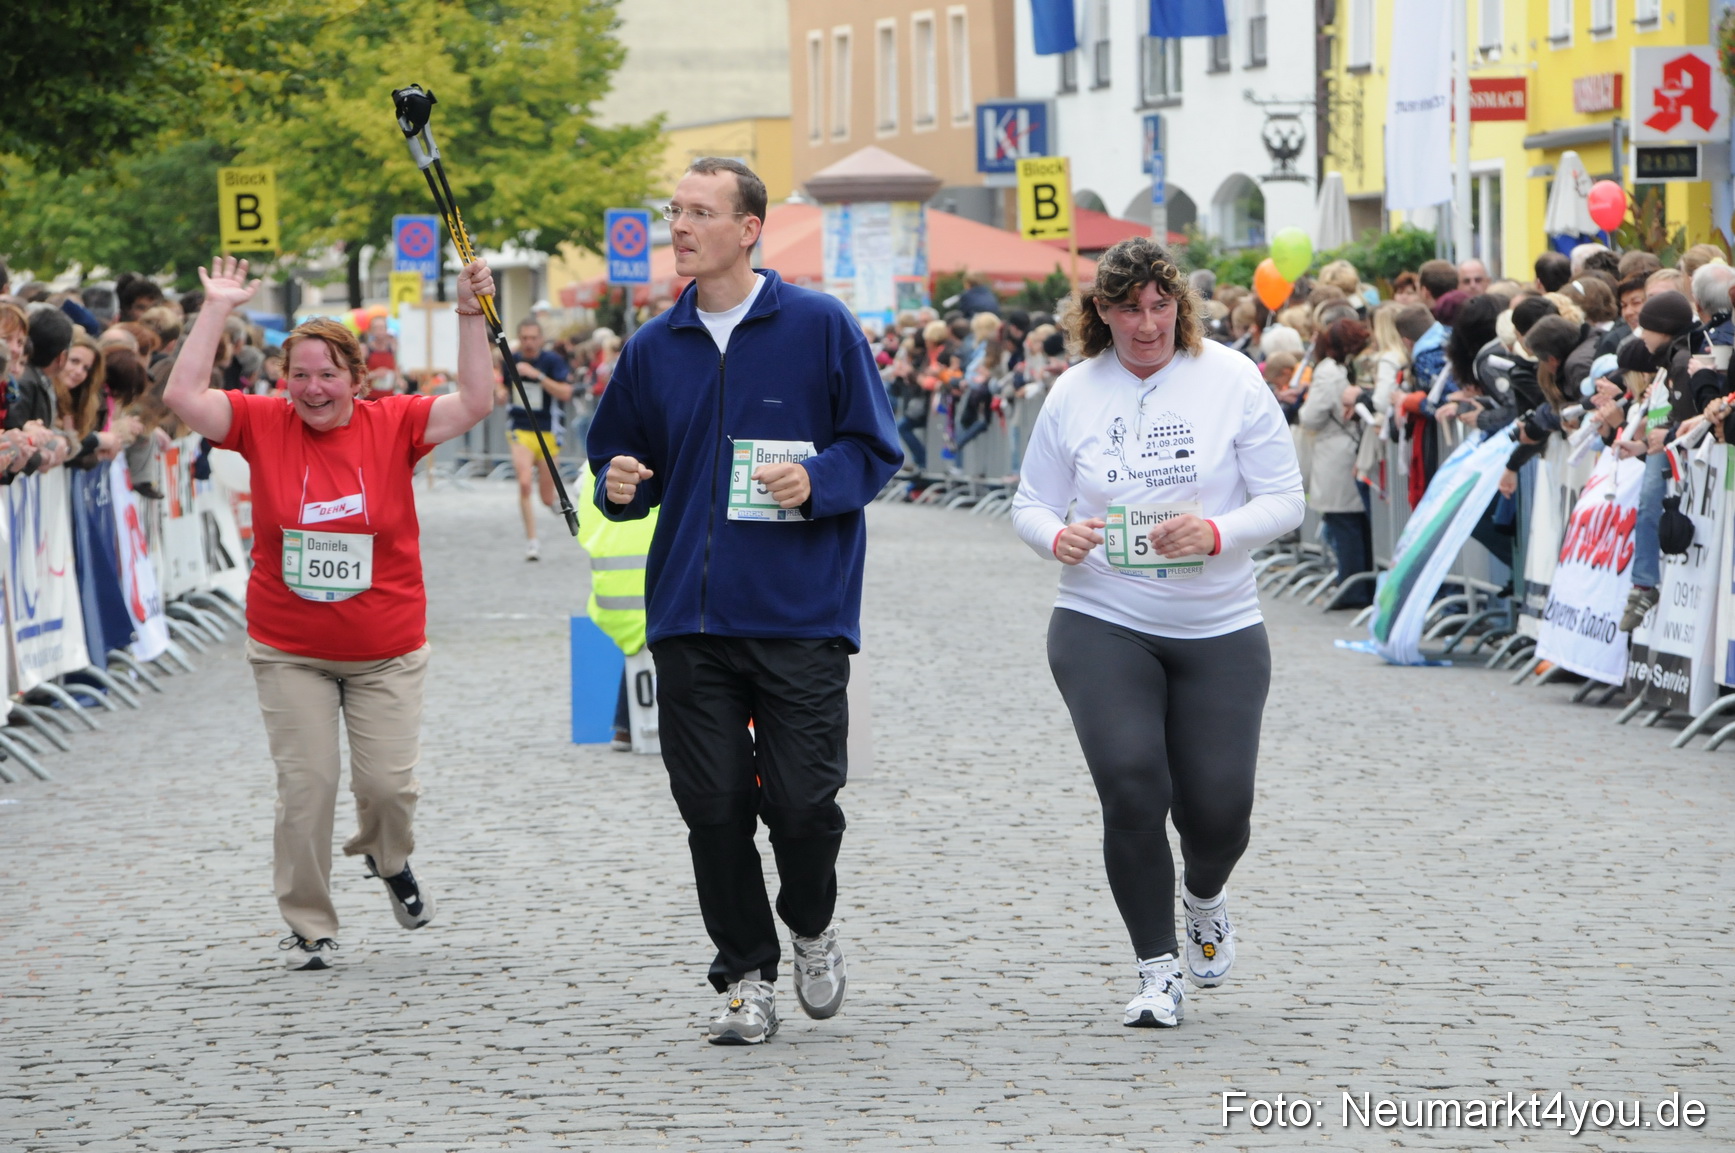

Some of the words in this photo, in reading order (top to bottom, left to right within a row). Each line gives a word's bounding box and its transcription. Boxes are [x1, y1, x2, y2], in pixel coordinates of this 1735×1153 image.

[1023, 162, 1065, 177] Block
[225, 171, 266, 187] Block
[1033, 184, 1059, 221] B
[235, 193, 262, 231] B
[610, 260, 648, 278] TAXI
[1146, 437, 1194, 449] 21.09.2008
[756, 448, 808, 464] Bernhard
[734, 471, 740, 482] S
[1107, 469, 1124, 483] 9.
[1128, 464, 1196, 480] Neumarkter
[1145, 472, 1198, 488] Stadtlauf
[319, 503, 347, 516] DEHN
[1131, 511, 1187, 526] Christin
[307, 537, 348, 552] Daniela
[1109, 535, 1116, 546] S
[286, 556, 293, 566] S
[308, 559, 361, 580] 5061
[1577, 606, 1617, 645] Radio
